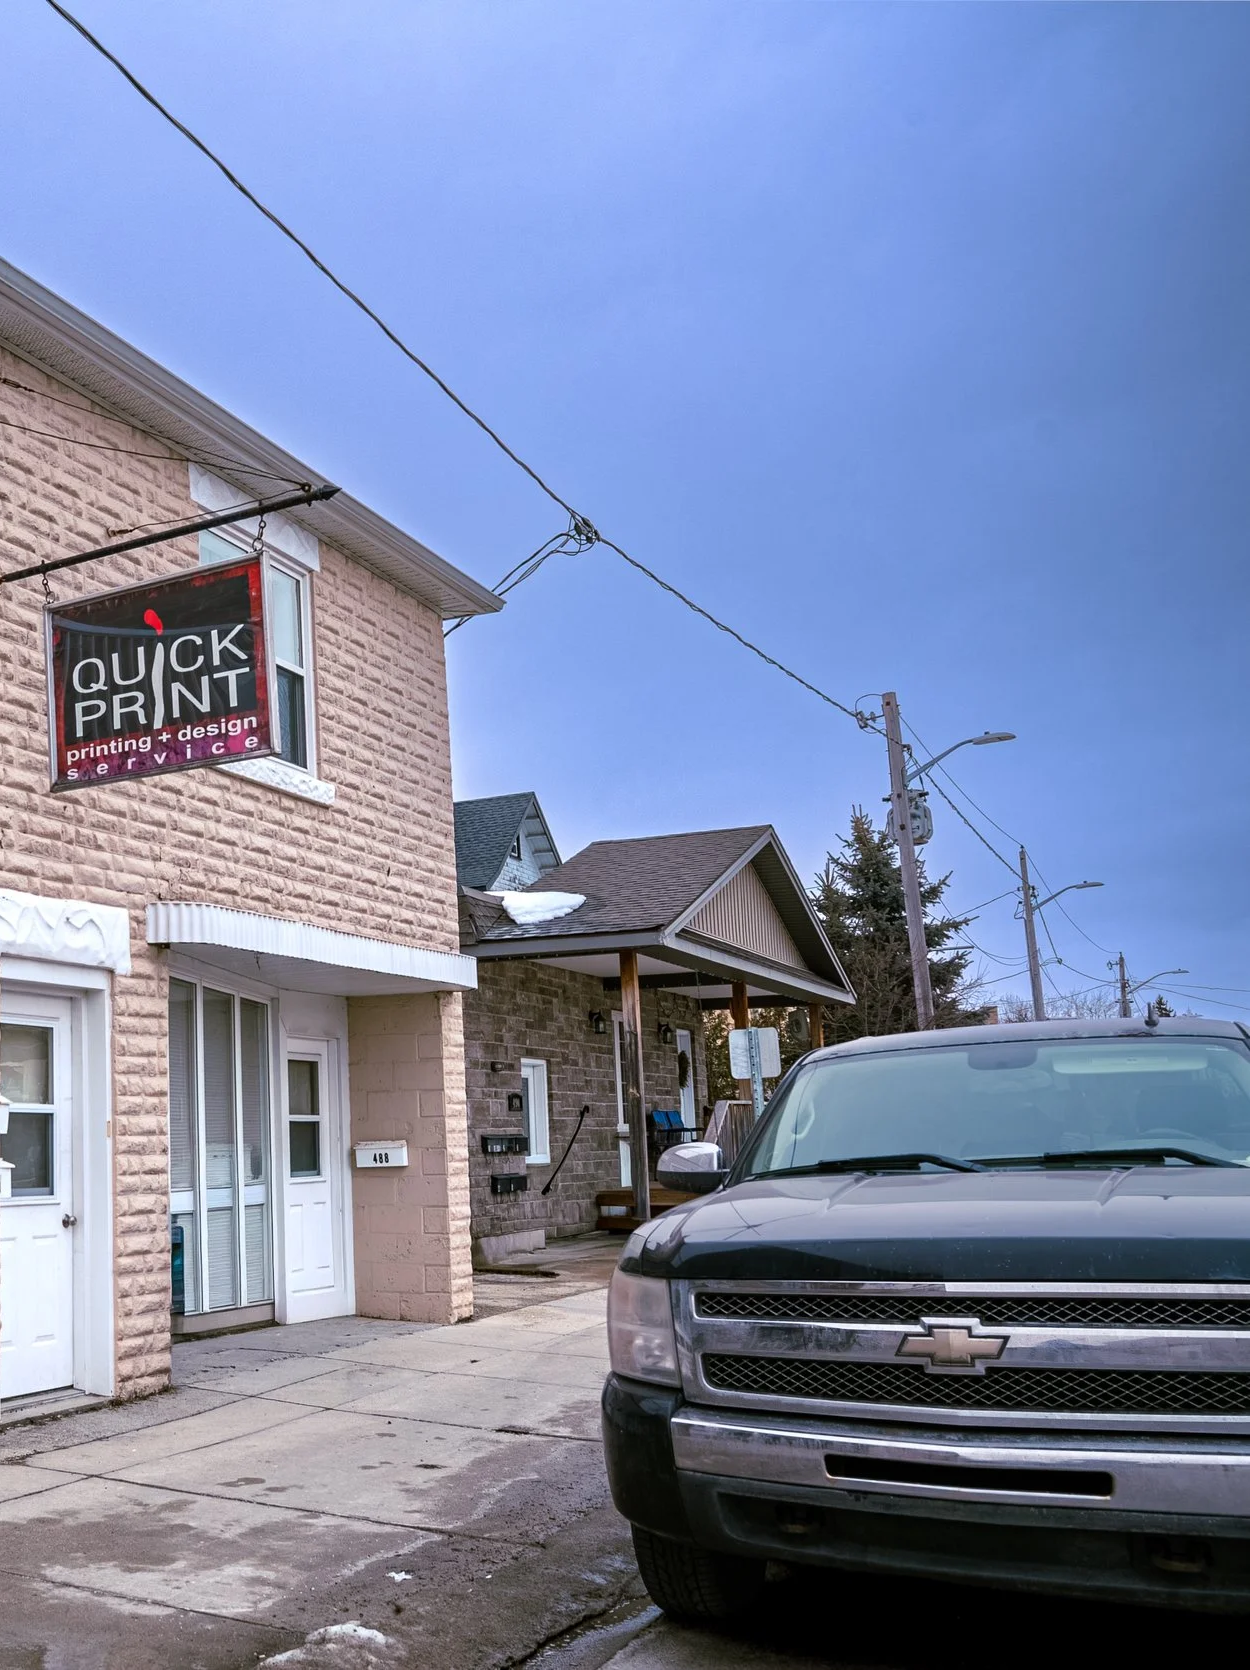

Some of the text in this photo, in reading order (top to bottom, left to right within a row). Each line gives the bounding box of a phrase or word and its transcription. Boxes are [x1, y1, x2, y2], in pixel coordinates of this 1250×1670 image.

[72, 624, 249, 694] QUICK
[74, 667, 250, 738] PRINT
[67, 733, 152, 765] printing
[178, 714, 258, 742] design
[67, 735, 259, 781] service
[372, 1152, 390, 1164] 488
